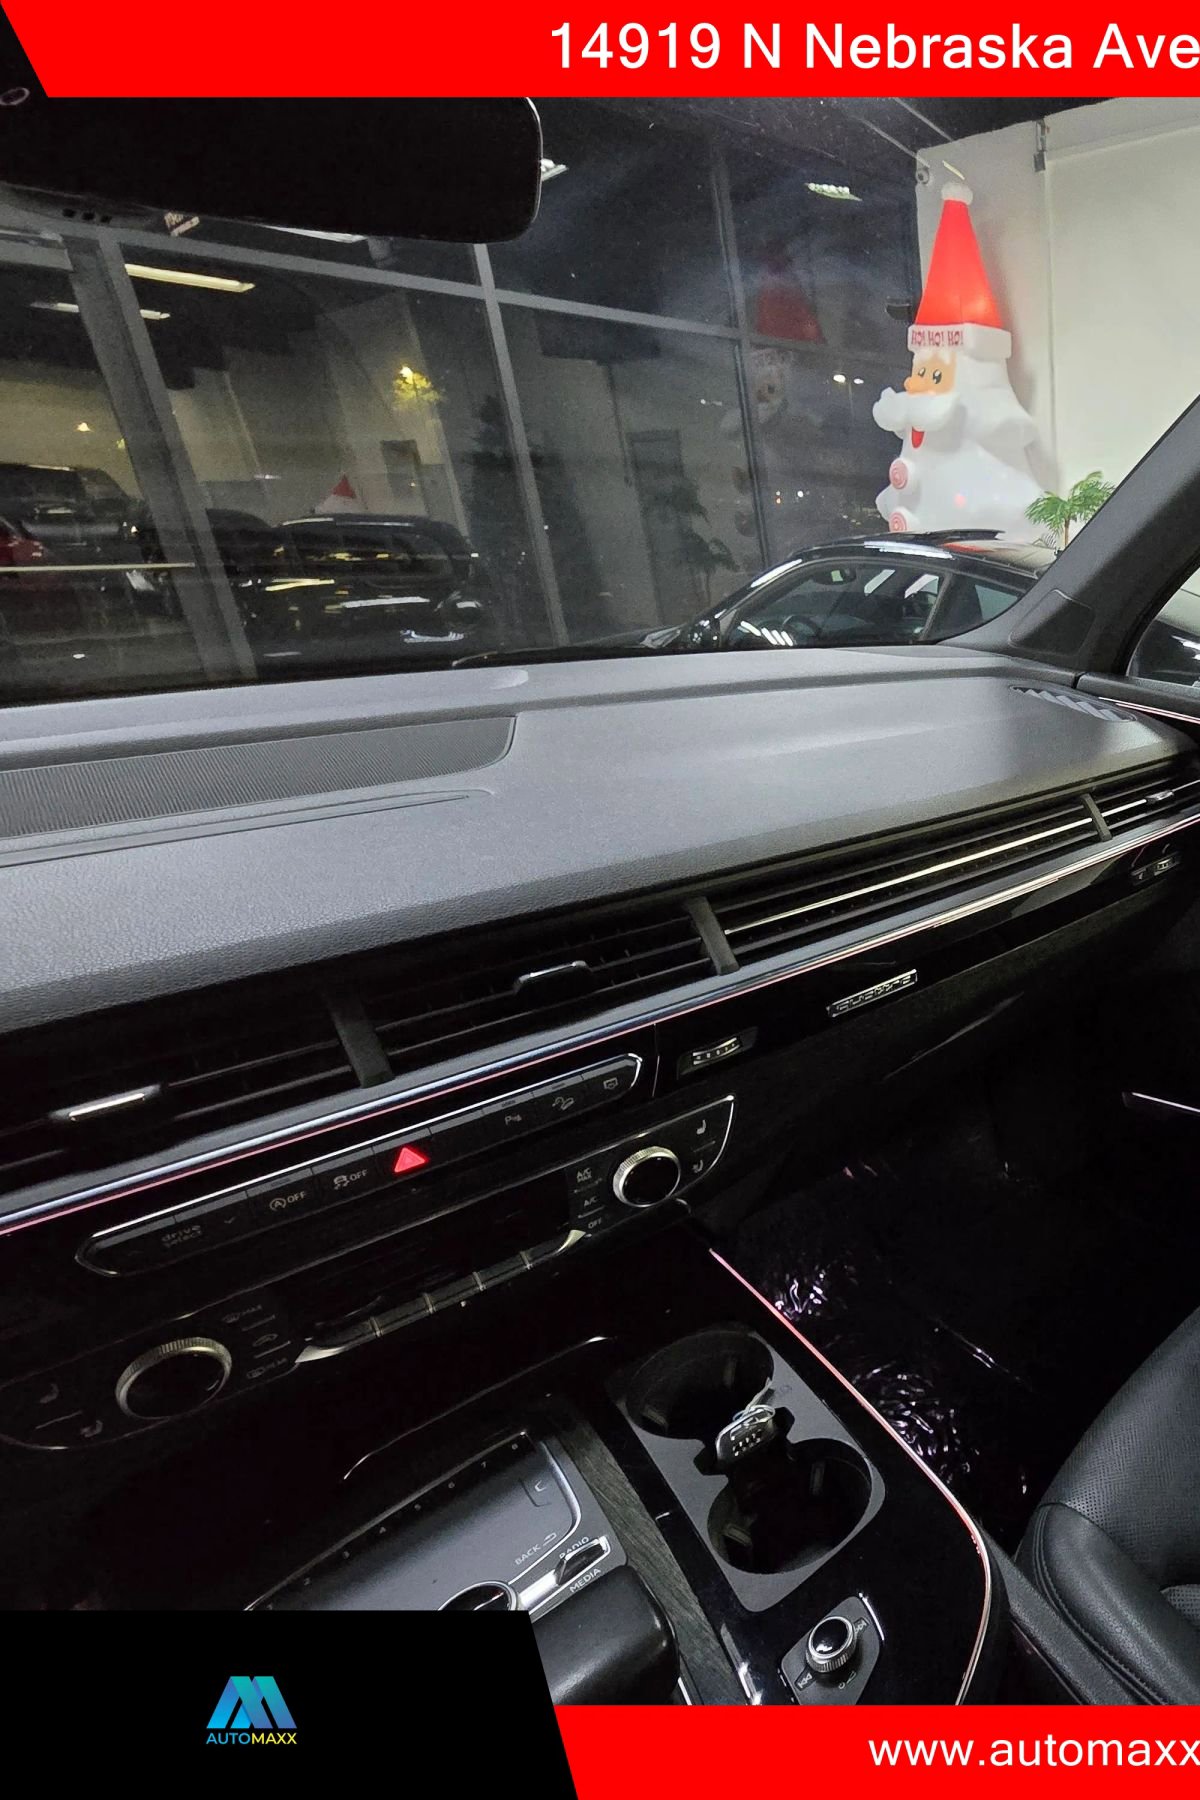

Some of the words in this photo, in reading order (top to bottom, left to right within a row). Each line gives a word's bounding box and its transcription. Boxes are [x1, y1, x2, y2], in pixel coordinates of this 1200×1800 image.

[911, 330, 925, 346] HO!
[928, 331, 944, 347] HO!
[948, 330, 964, 346] HO!
[349, 1169, 368, 1182] OFF
[287, 1191, 306, 1204] OFF
[514, 1543, 541, 1566] BACK
[569, 1568, 602, 1593] MEDIA
